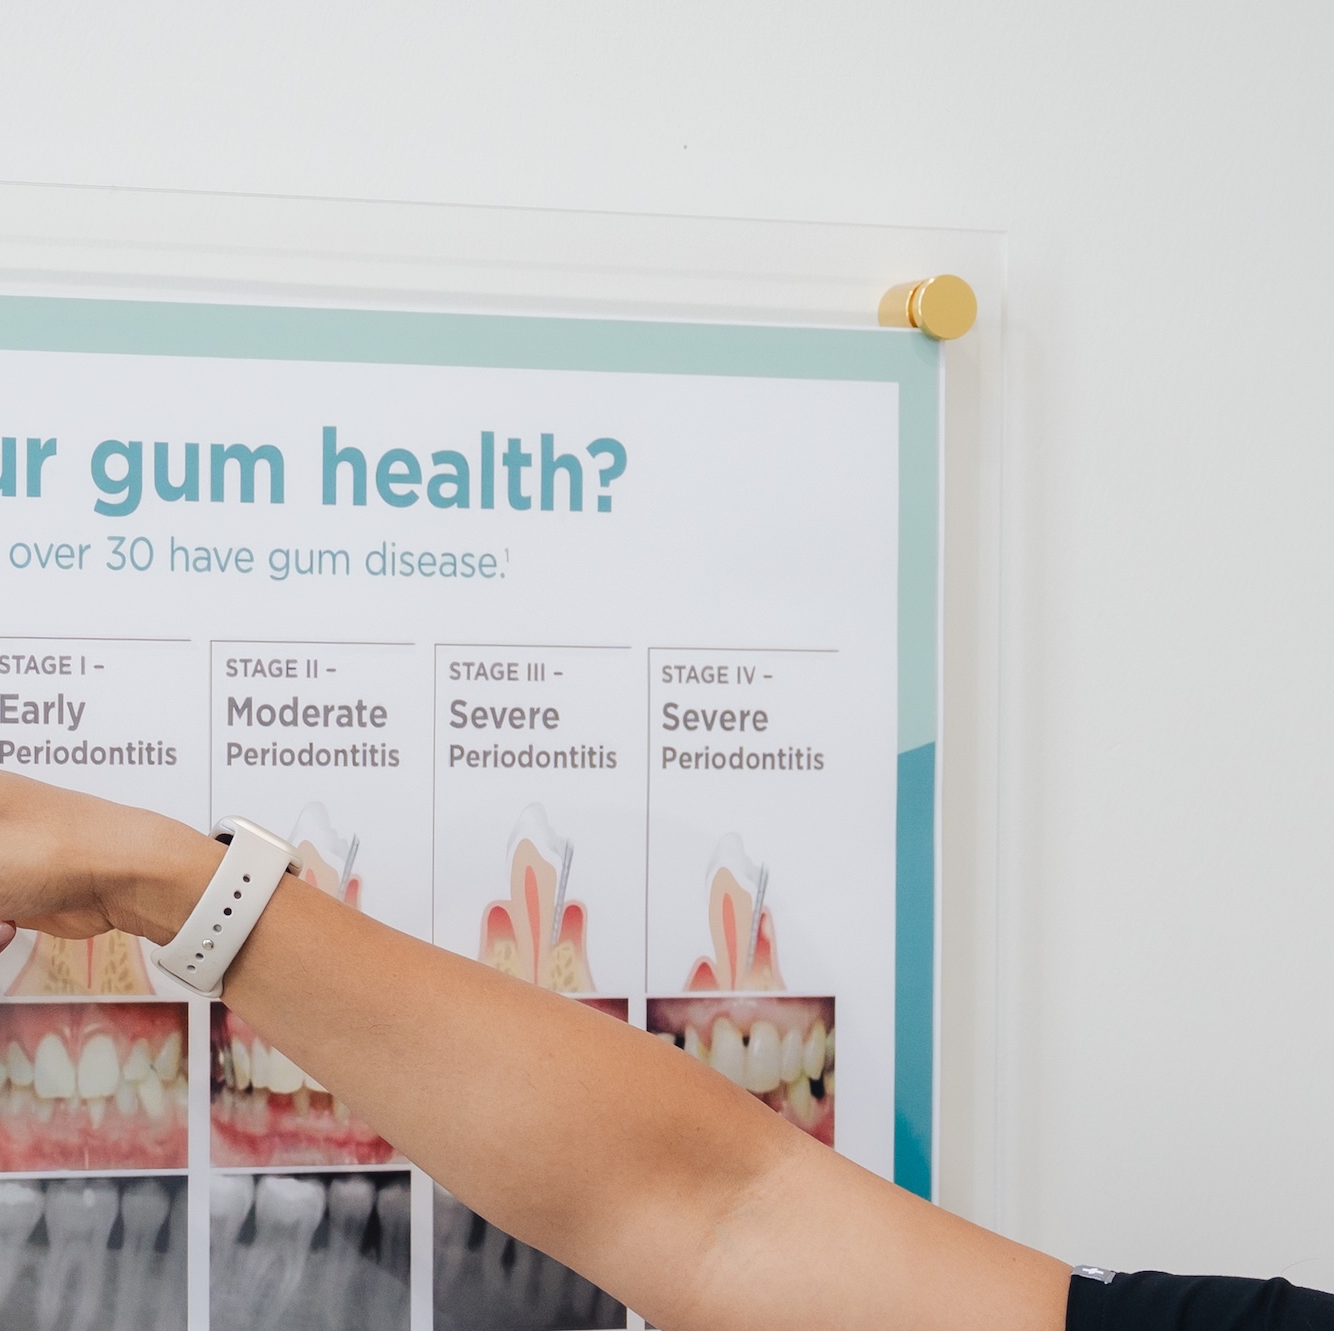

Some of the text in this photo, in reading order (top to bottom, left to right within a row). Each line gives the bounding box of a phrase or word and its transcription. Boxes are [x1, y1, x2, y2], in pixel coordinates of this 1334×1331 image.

[91, 440, 284, 517] gum
[322, 426, 627, 512] health?
[9, 543, 91, 570] over
[106, 536, 154, 571] 30
[171, 536, 254, 573] have
[269, 549, 349, 581] gum
[226, 659, 297, 678] STAGE
[307, 659, 317, 678] II
[450, 662, 519, 681] STAGE
[528, 663, 545, 681] III
[662, 665, 729, 684] STAGE
[737, 666, 755, 685] IV
[0, 693, 86, 731] Early
[228, 696, 387, 728] Moderate
[450, 700, 559, 729] Severe
[663, 702, 768, 732] Severe
[227, 742, 399, 767] Periodontitis
[450, 744, 617, 768] Periodontitis
[663, 746, 824, 770] Periodontitis
